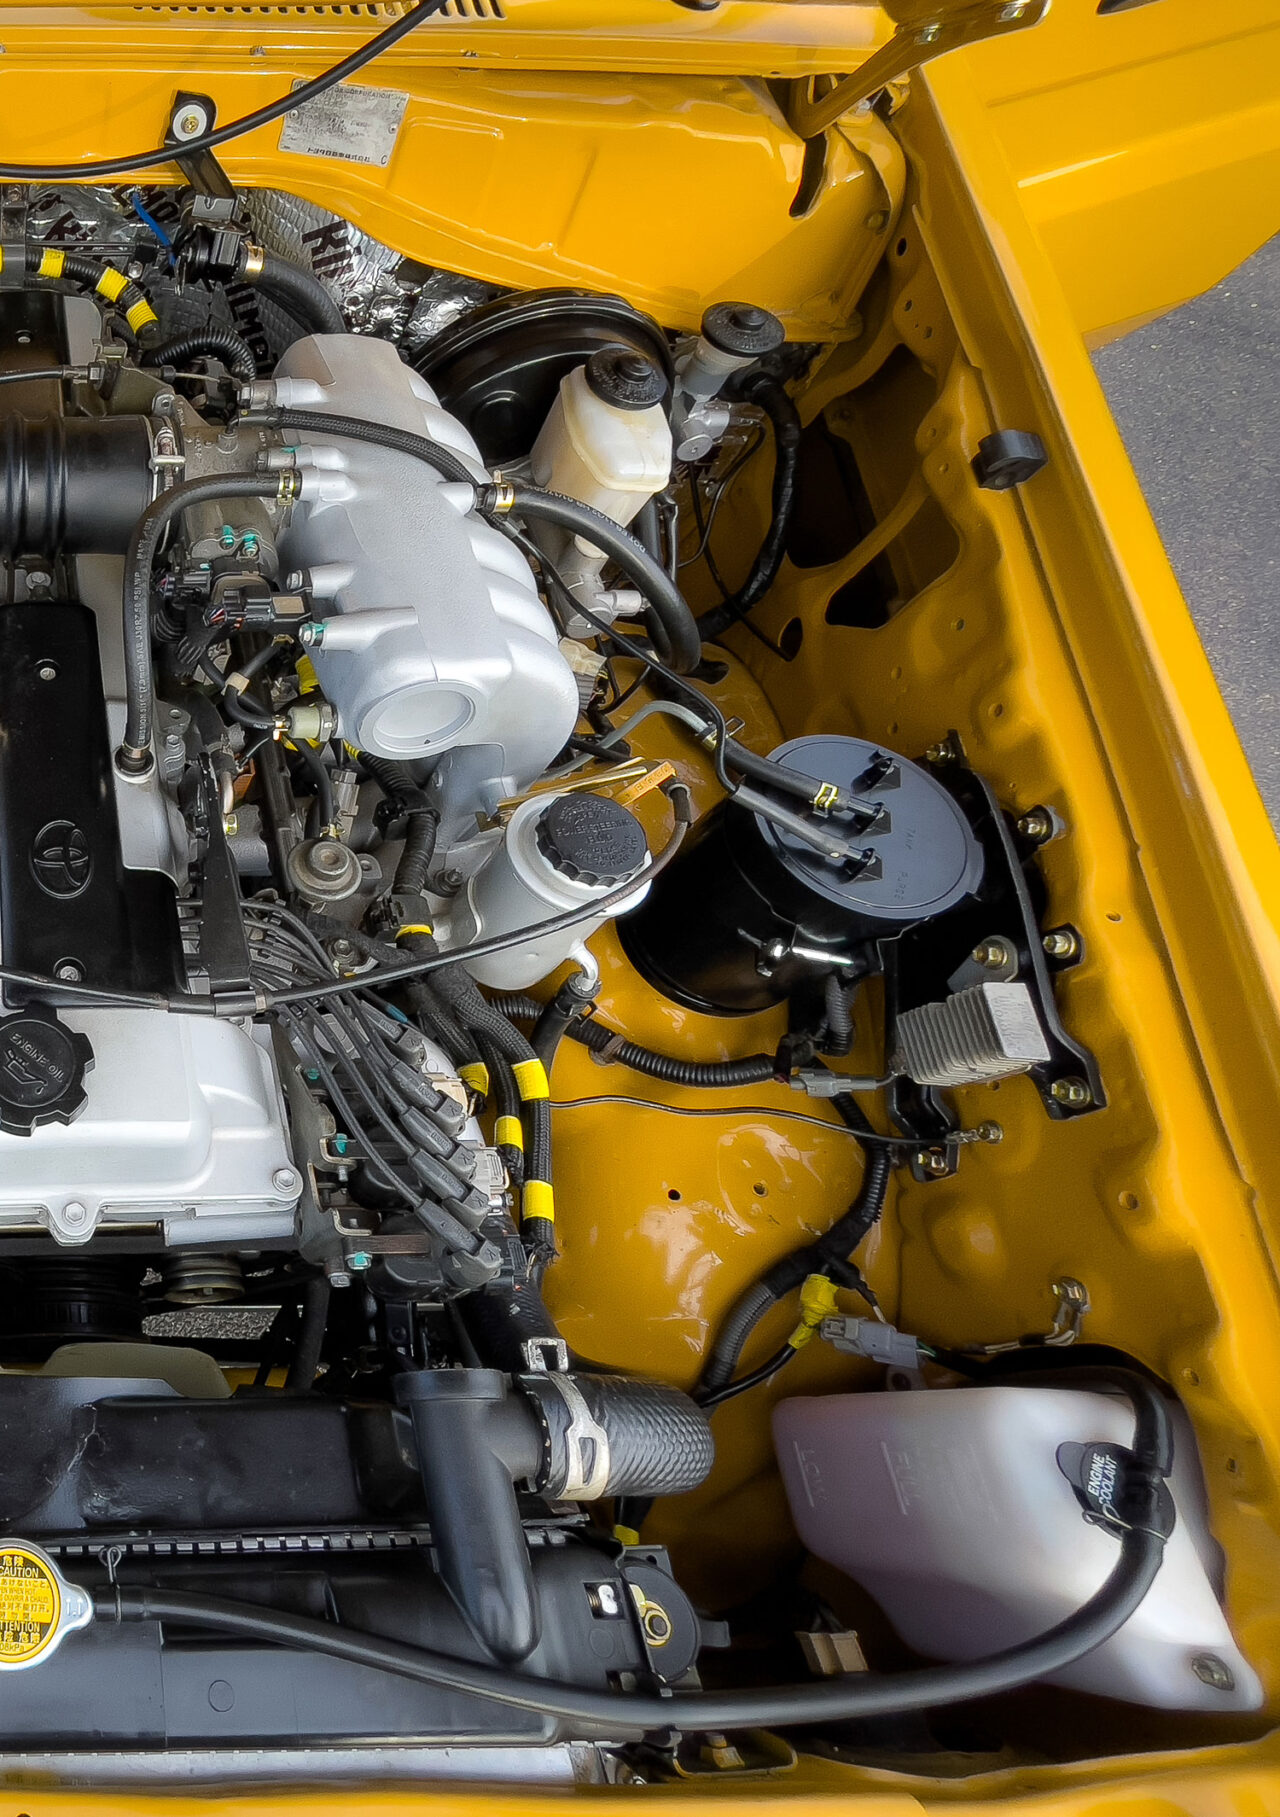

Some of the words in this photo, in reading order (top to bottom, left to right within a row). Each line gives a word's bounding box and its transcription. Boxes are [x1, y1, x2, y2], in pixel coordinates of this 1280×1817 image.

[9, 1032, 50, 1067] ENGINE
[48, 1065, 65, 1083] OIL
[1087, 1452, 1106, 1497] ENGINE
[1098, 1454, 1117, 1505] COOLANT
